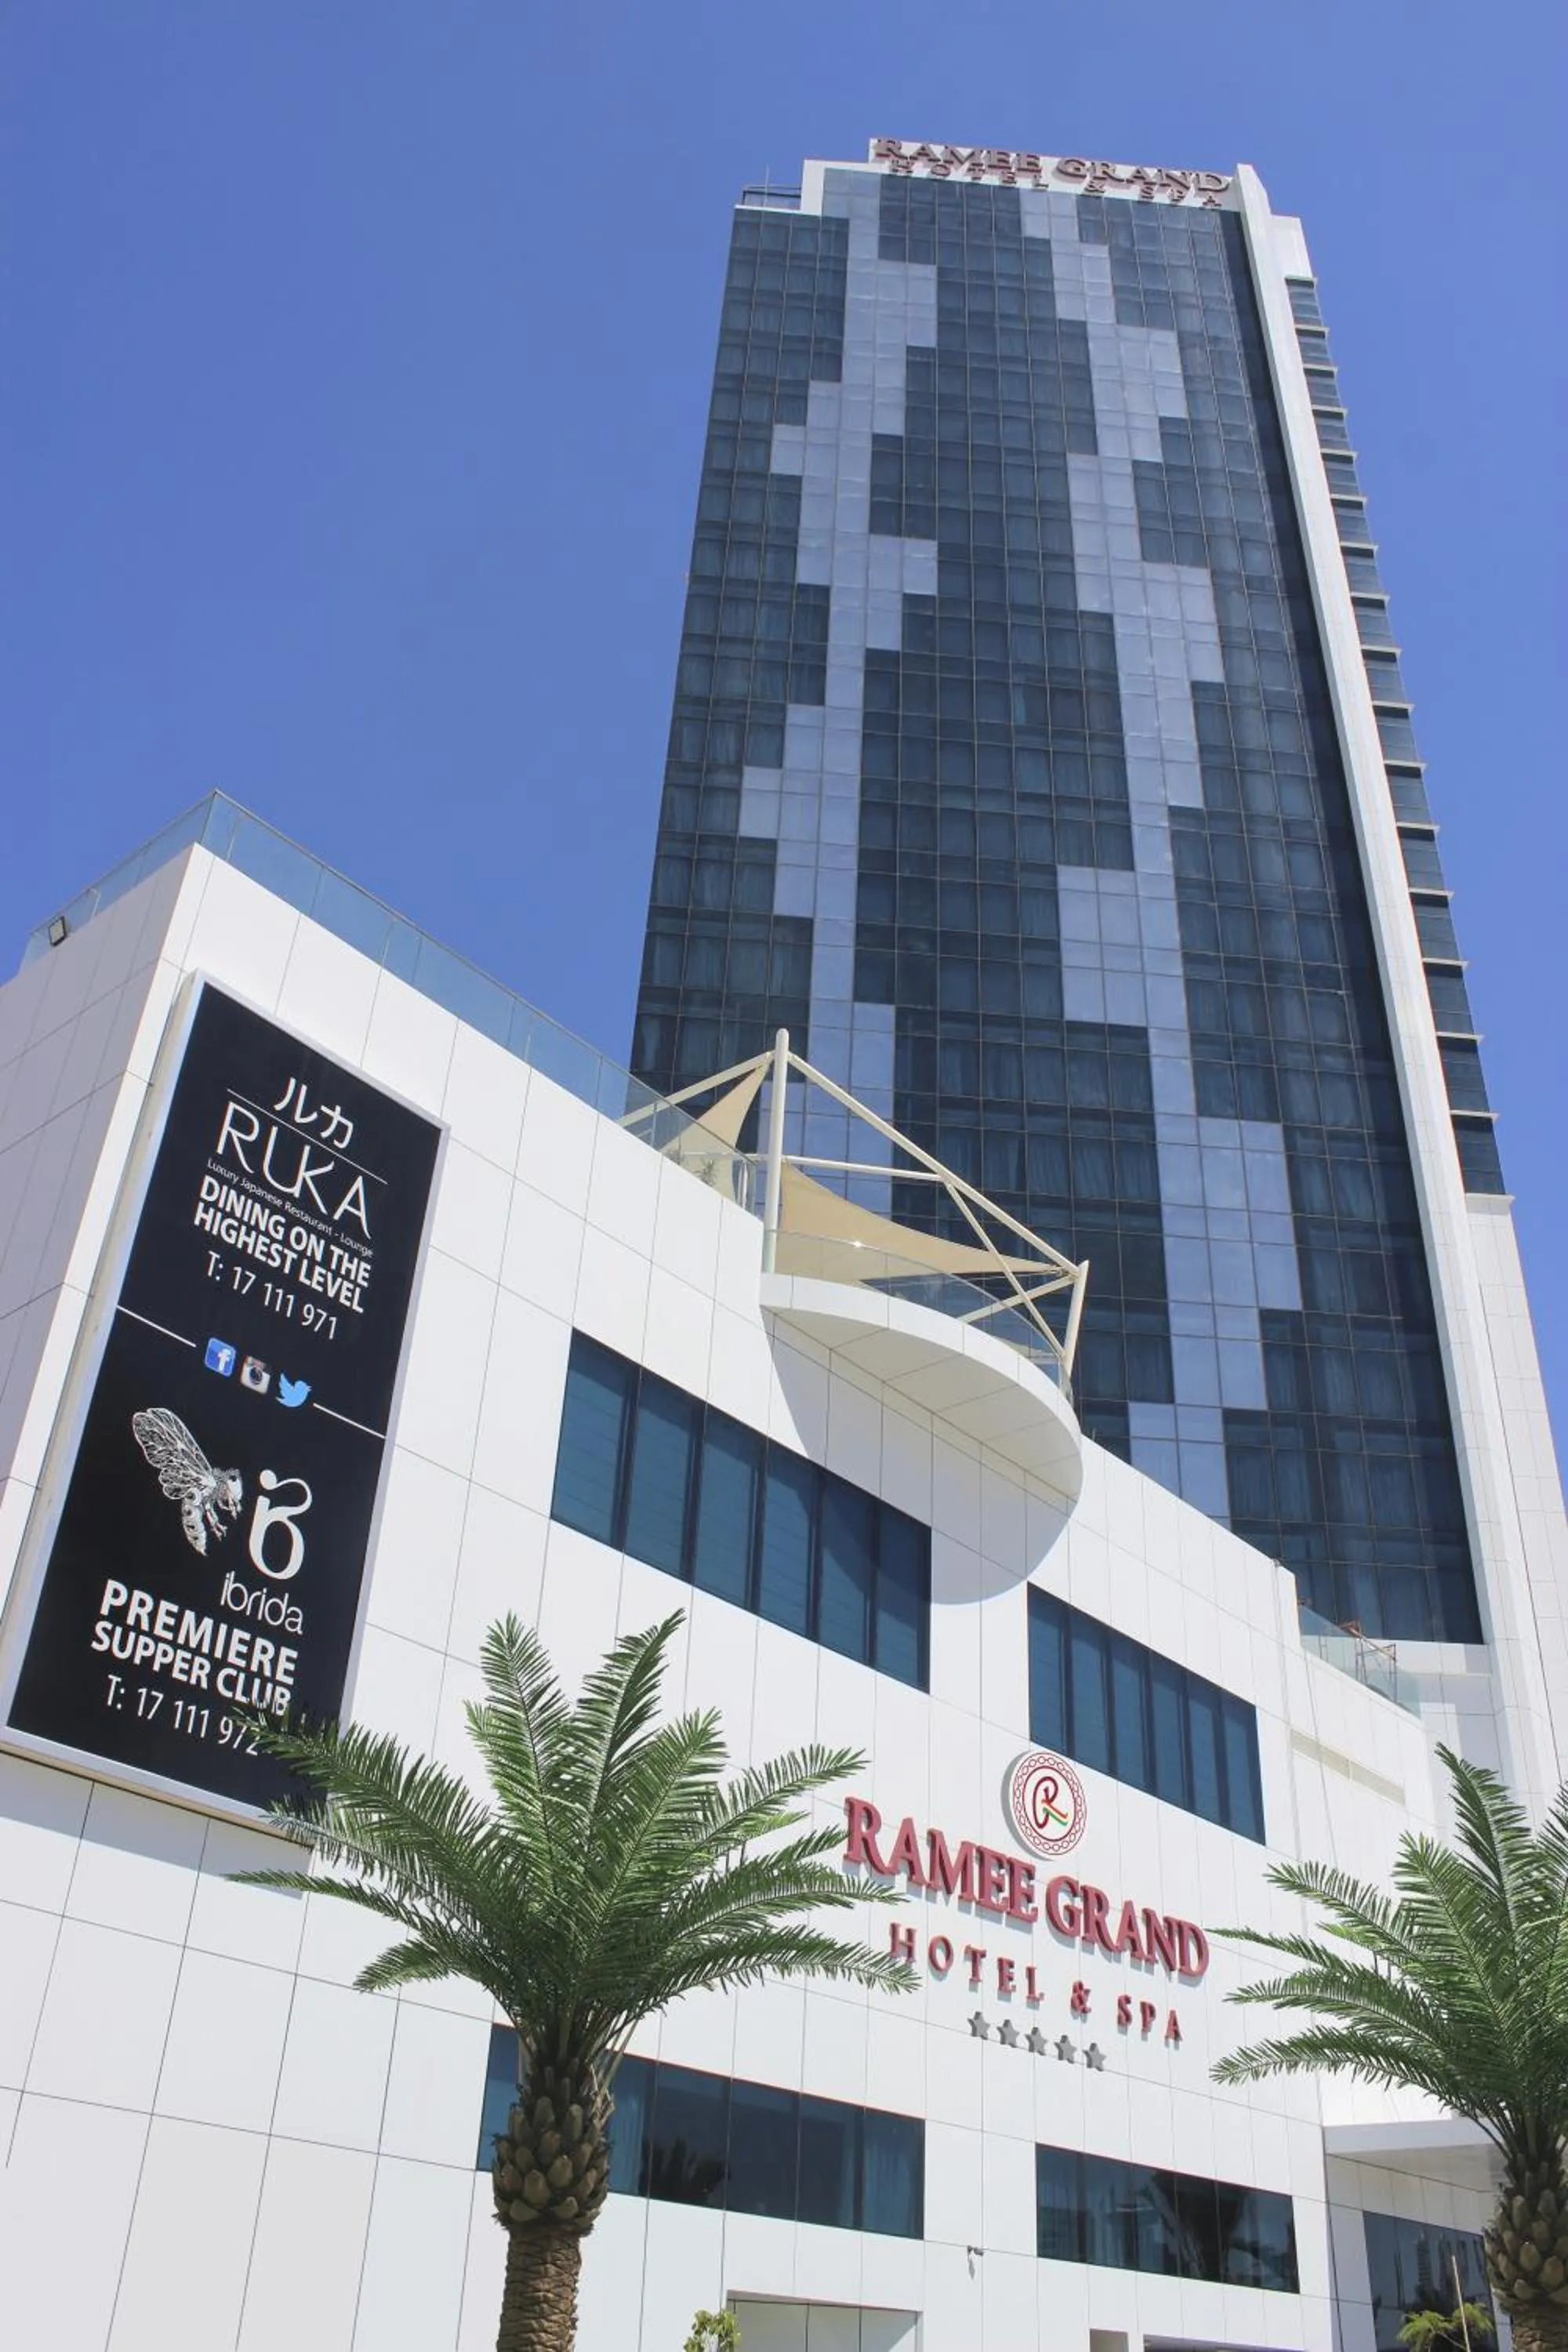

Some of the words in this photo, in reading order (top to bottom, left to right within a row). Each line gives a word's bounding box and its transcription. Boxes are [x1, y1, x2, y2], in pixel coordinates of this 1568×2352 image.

[875, 138, 1043, 173] RAMEE
[1056, 158, 1230, 193] GRAND
[274, 1077, 353, 1149] ルカ
[207, 1157, 238, 1184] Luxury
[240, 1178, 283, 1208] Japanese
[285, 1200, 332, 1236] Restaurant
[339, 1232, 373, 1258] Lounge
[216, 1101, 371, 1240] RUKA
[194, 1202, 299, 1275] HIGHEST
[299, 1258, 364, 1314] LEVEL
[199, 1174, 285, 1240] DINING
[289, 1225, 325, 1263] ON
[329, 1244, 371, 1288] THE
[207, 1250, 223, 1281] T:
[233, 1266, 256, 1295] 17
[263, 1283, 294, 1318] 111
[302, 1304, 338, 1340] 971
[100, 1578, 299, 1686] PREMIERE
[220, 1570, 303, 1635] ibrida
[91, 1620, 212, 1690] SUPPER
[216, 1668, 292, 1716] CLUB
[107, 1674, 125, 1710] T:
[137, 1688, 164, 1720] 17
[174, 1700, 209, 1738] 111
[843, 1795, 1038, 1924] RAMEE
[1045, 1875, 1210, 1980] GRAND
[888, 1922, 1045, 2003] HOTEL
[1069, 1980, 1092, 2014] &
[1116, 1994, 1183, 2042] SPA
